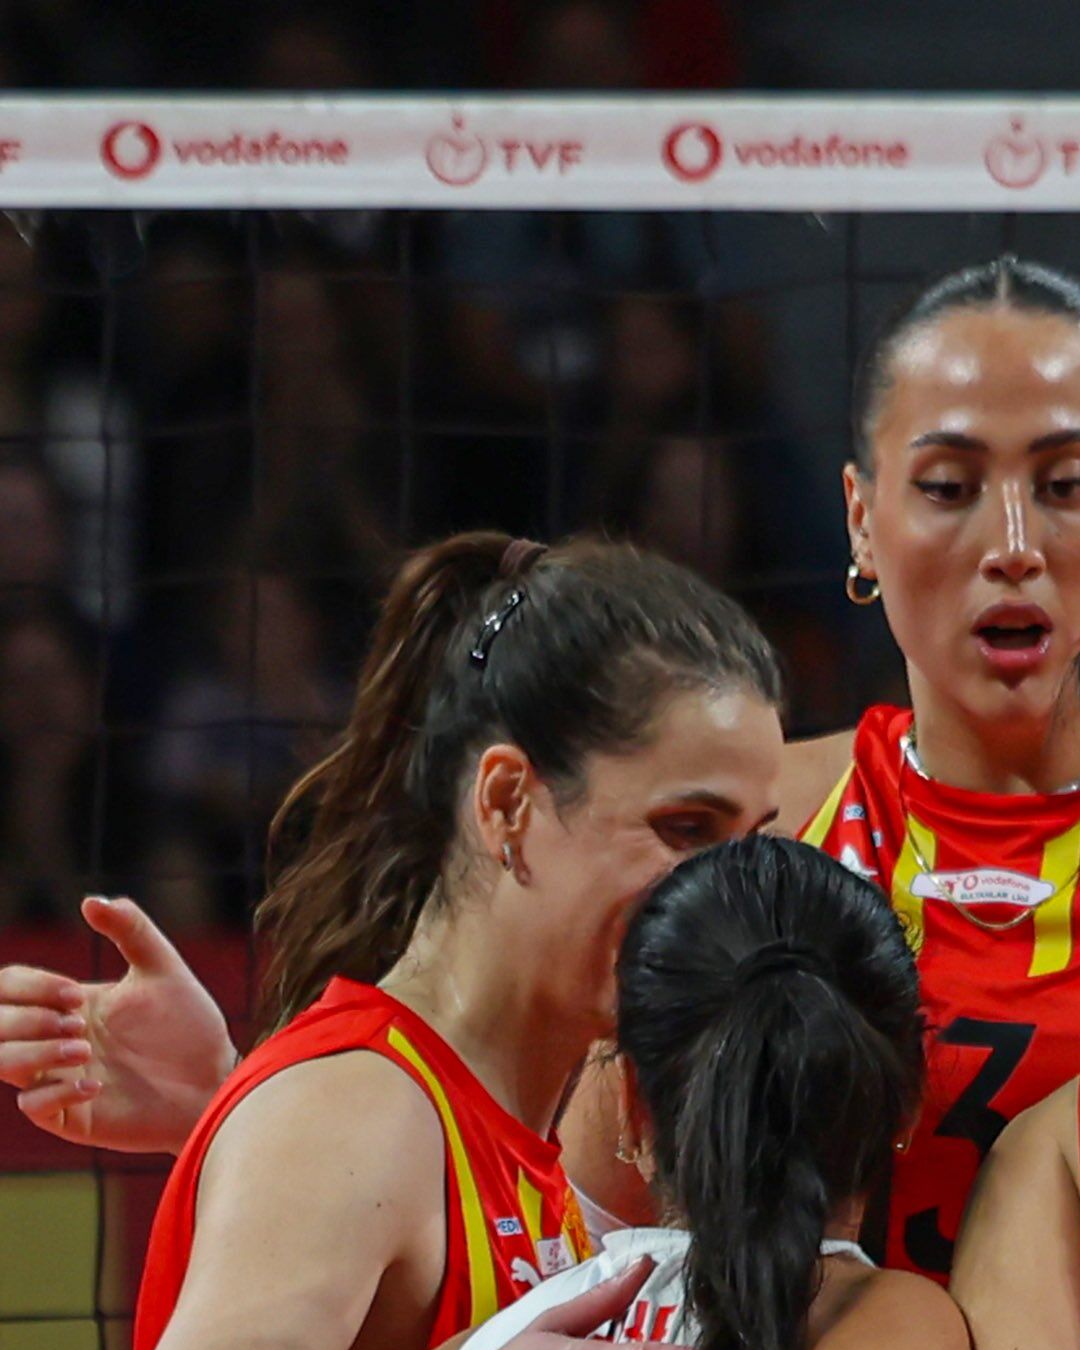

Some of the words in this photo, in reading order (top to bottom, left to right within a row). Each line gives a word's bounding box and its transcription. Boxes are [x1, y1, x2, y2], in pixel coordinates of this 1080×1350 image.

[174, 132, 350, 165] vodafone
[499, 138, 585, 170] TVF
[735, 134, 910, 167] vodafone
